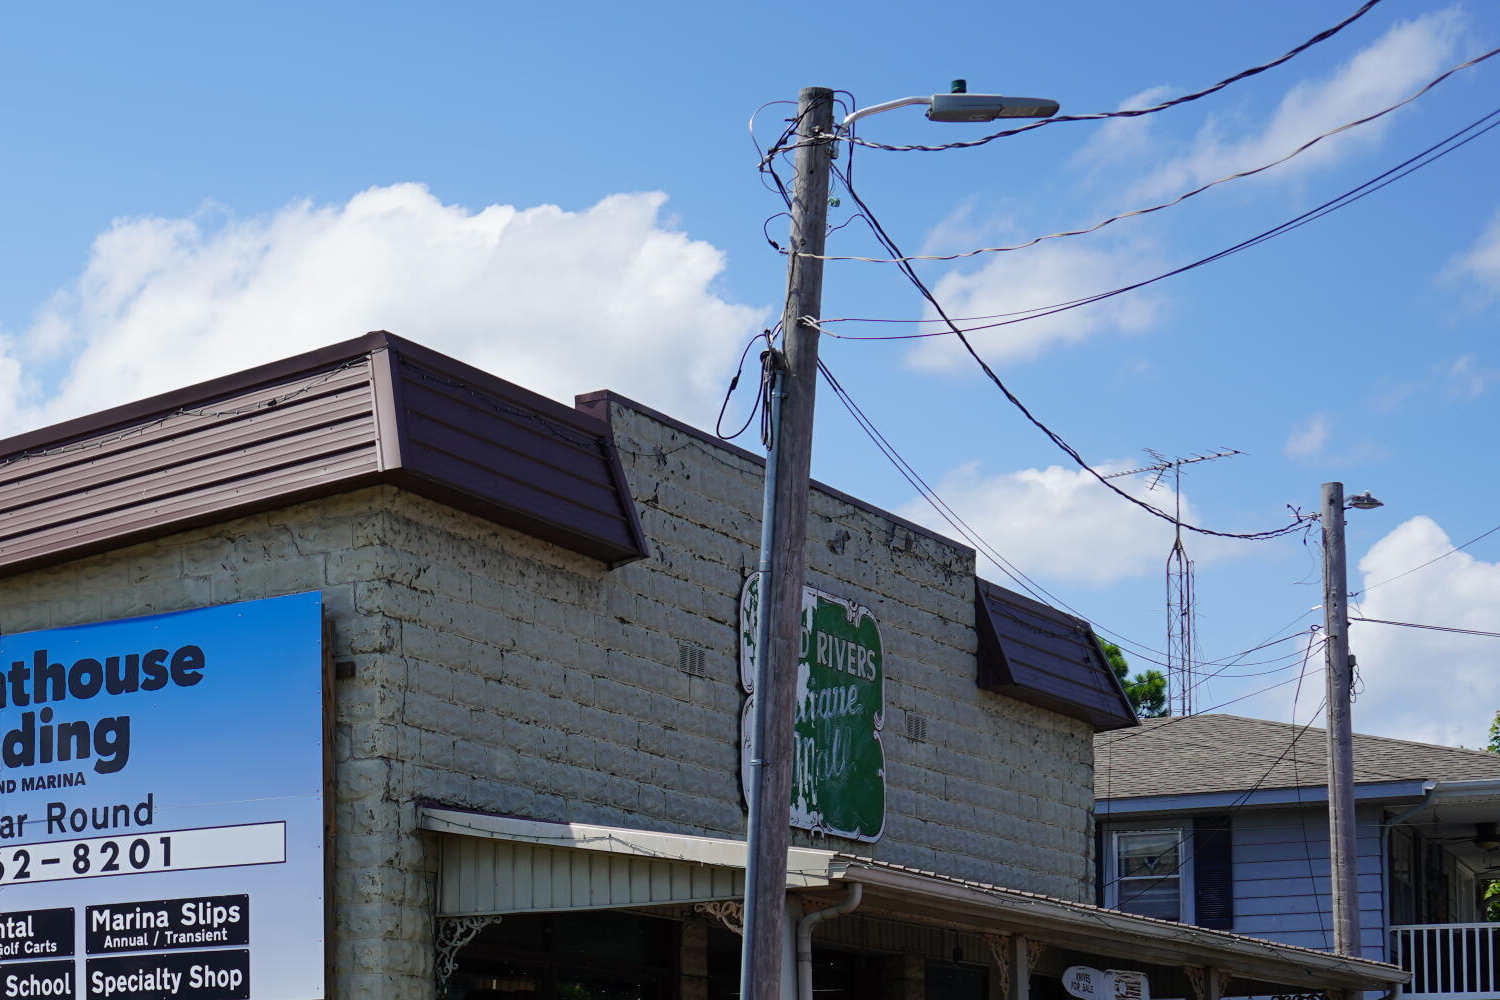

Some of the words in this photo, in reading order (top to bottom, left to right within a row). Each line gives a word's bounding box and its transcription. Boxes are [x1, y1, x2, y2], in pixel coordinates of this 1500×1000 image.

[816, 630, 876, 681] RIVERS
[21, 771, 86, 791] MARINA
[47, 793, 153, 835] Round
[92, 907, 169, 932] Marina
[180, 901, 241, 928] Slips
[24, 940, 57, 954] Carts
[104, 933, 148, 948] Annual
[153, 930, 159, 946] /
[165, 927, 228, 944] Transient
[5, 972, 71, 997] School
[91, 968, 182, 997] Specialty
[189, 965, 243, 991] Shop
[1071, 981, 1081, 992] FOR
[1082, 983, 1095, 993] SALE
